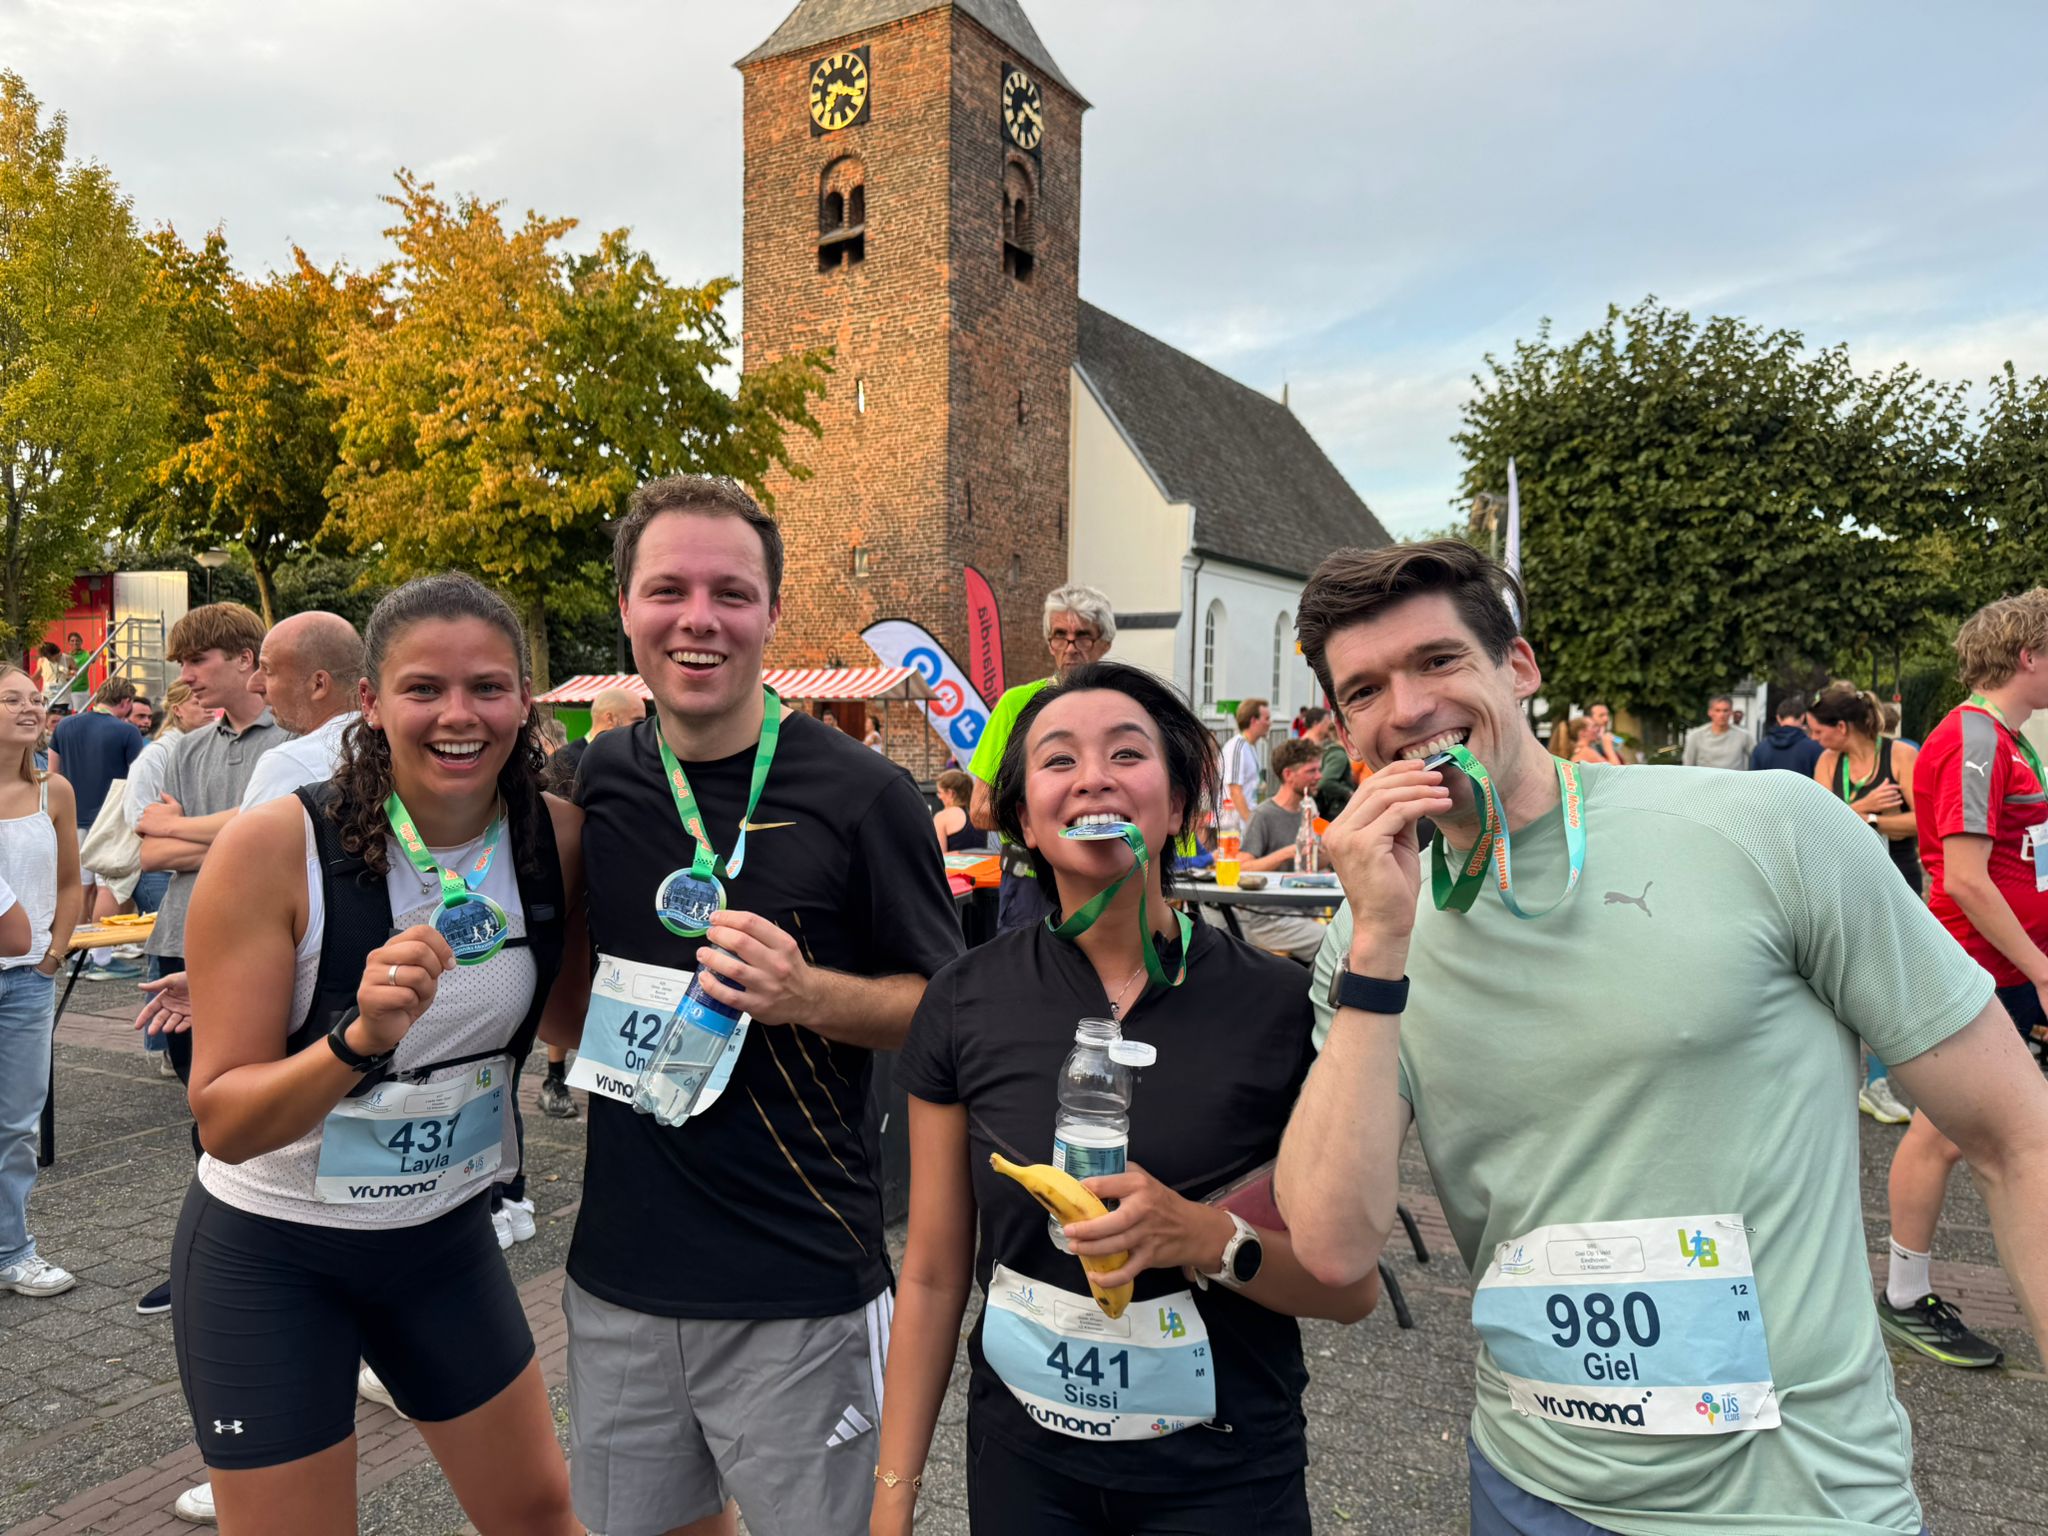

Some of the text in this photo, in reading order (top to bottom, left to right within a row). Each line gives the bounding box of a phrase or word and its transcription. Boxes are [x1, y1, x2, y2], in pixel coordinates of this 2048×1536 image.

[1466, 832, 1492, 877] Mooiste
[1494, 837, 1510, 891] Bunniks
[596, 1073, 635, 1098] vrumo
[388, 1112, 461, 1154] 437
[400, 1154, 449, 1174] Layla
[349, 1178, 438, 1199] vrumona
[1730, 1284, 1749, 1296] 12
[1546, 1291, 1661, 1349] 980
[1737, 1310, 1750, 1322] M
[1047, 1341, 1129, 1389] 441
[1192, 1347, 1205, 1358] 12
[1195, 1368, 1205, 1377] M
[1583, 1352, 1639, 1381] Giel
[1064, 1383, 1118, 1410] Sissi
[1534, 1393, 1646, 1427] vrumona
